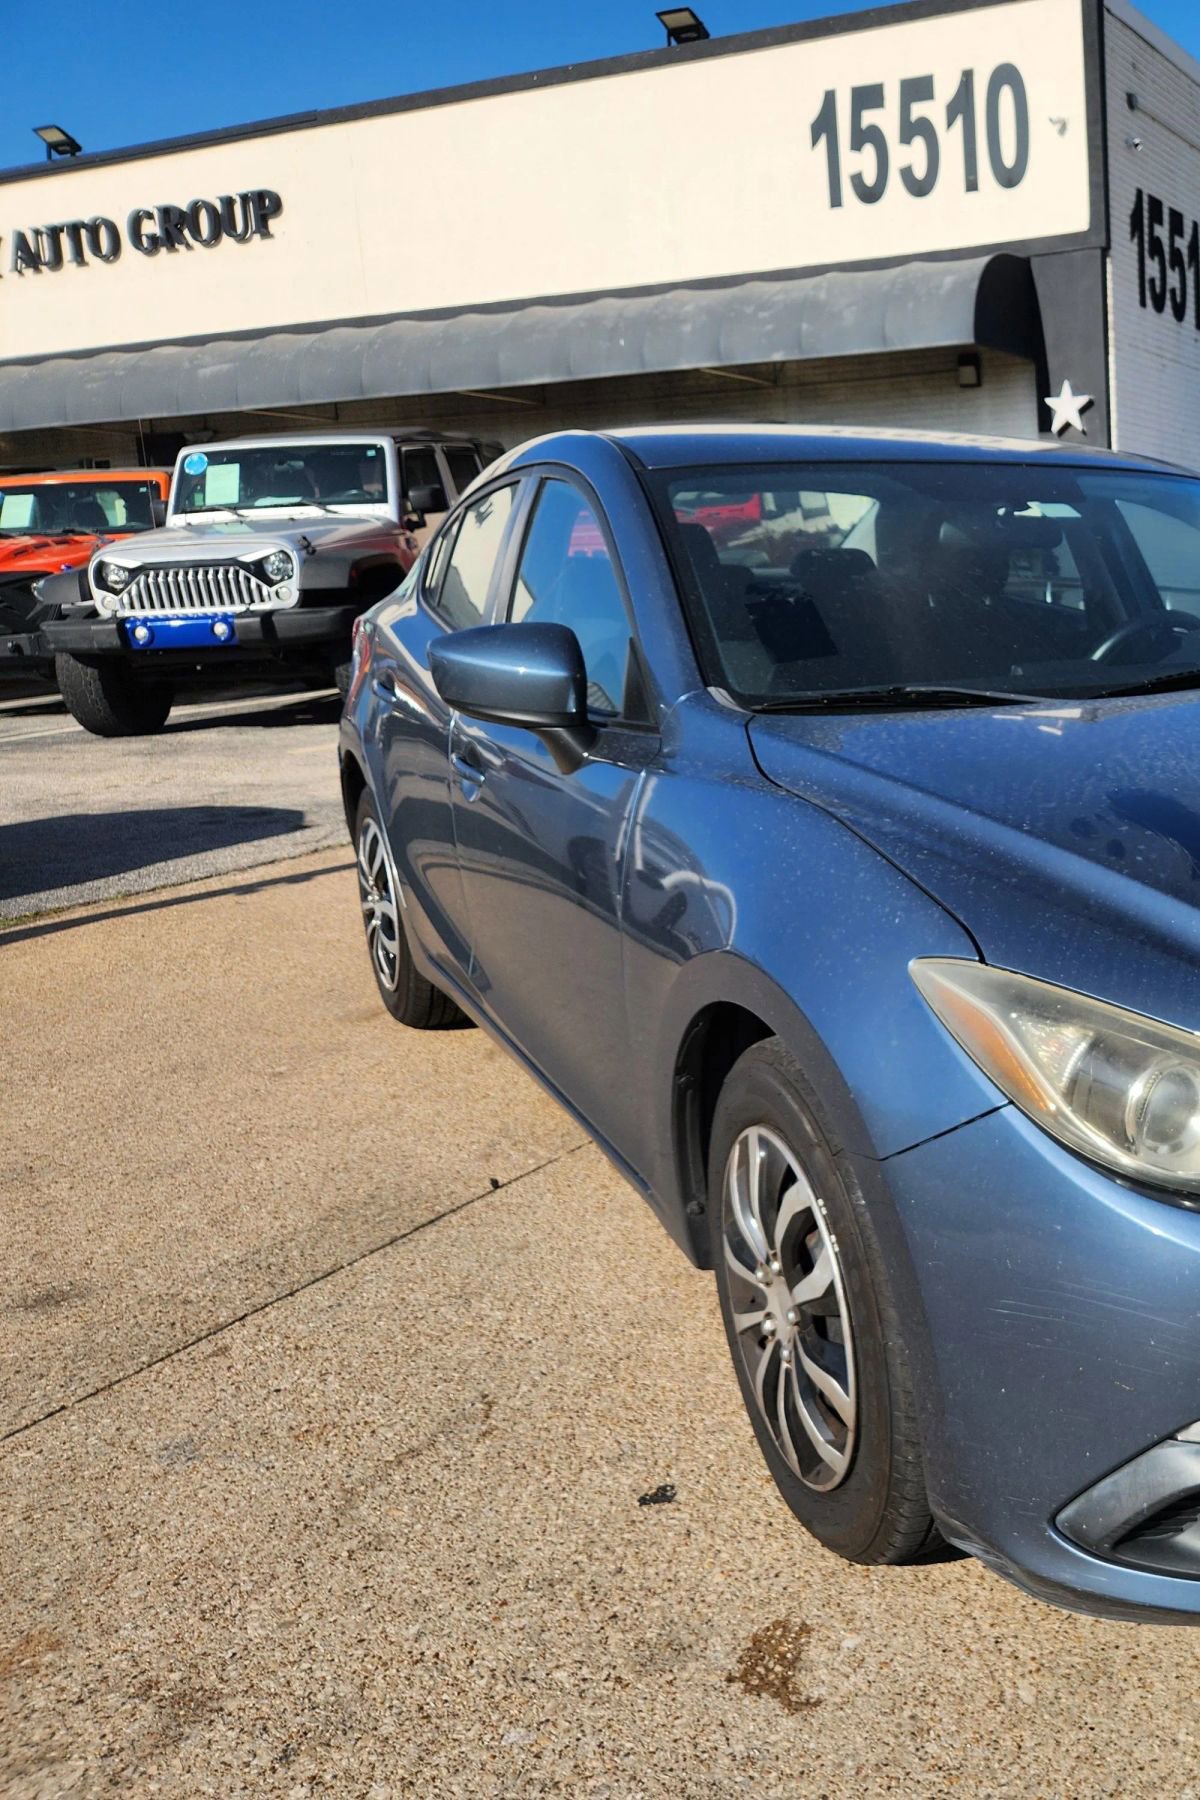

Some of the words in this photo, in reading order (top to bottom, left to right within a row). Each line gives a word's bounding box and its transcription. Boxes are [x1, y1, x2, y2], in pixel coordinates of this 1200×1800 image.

[811, 62, 1029, 209] 15510
[9, 215, 121, 277] AUTO
[127, 188, 284, 257] GROUP
